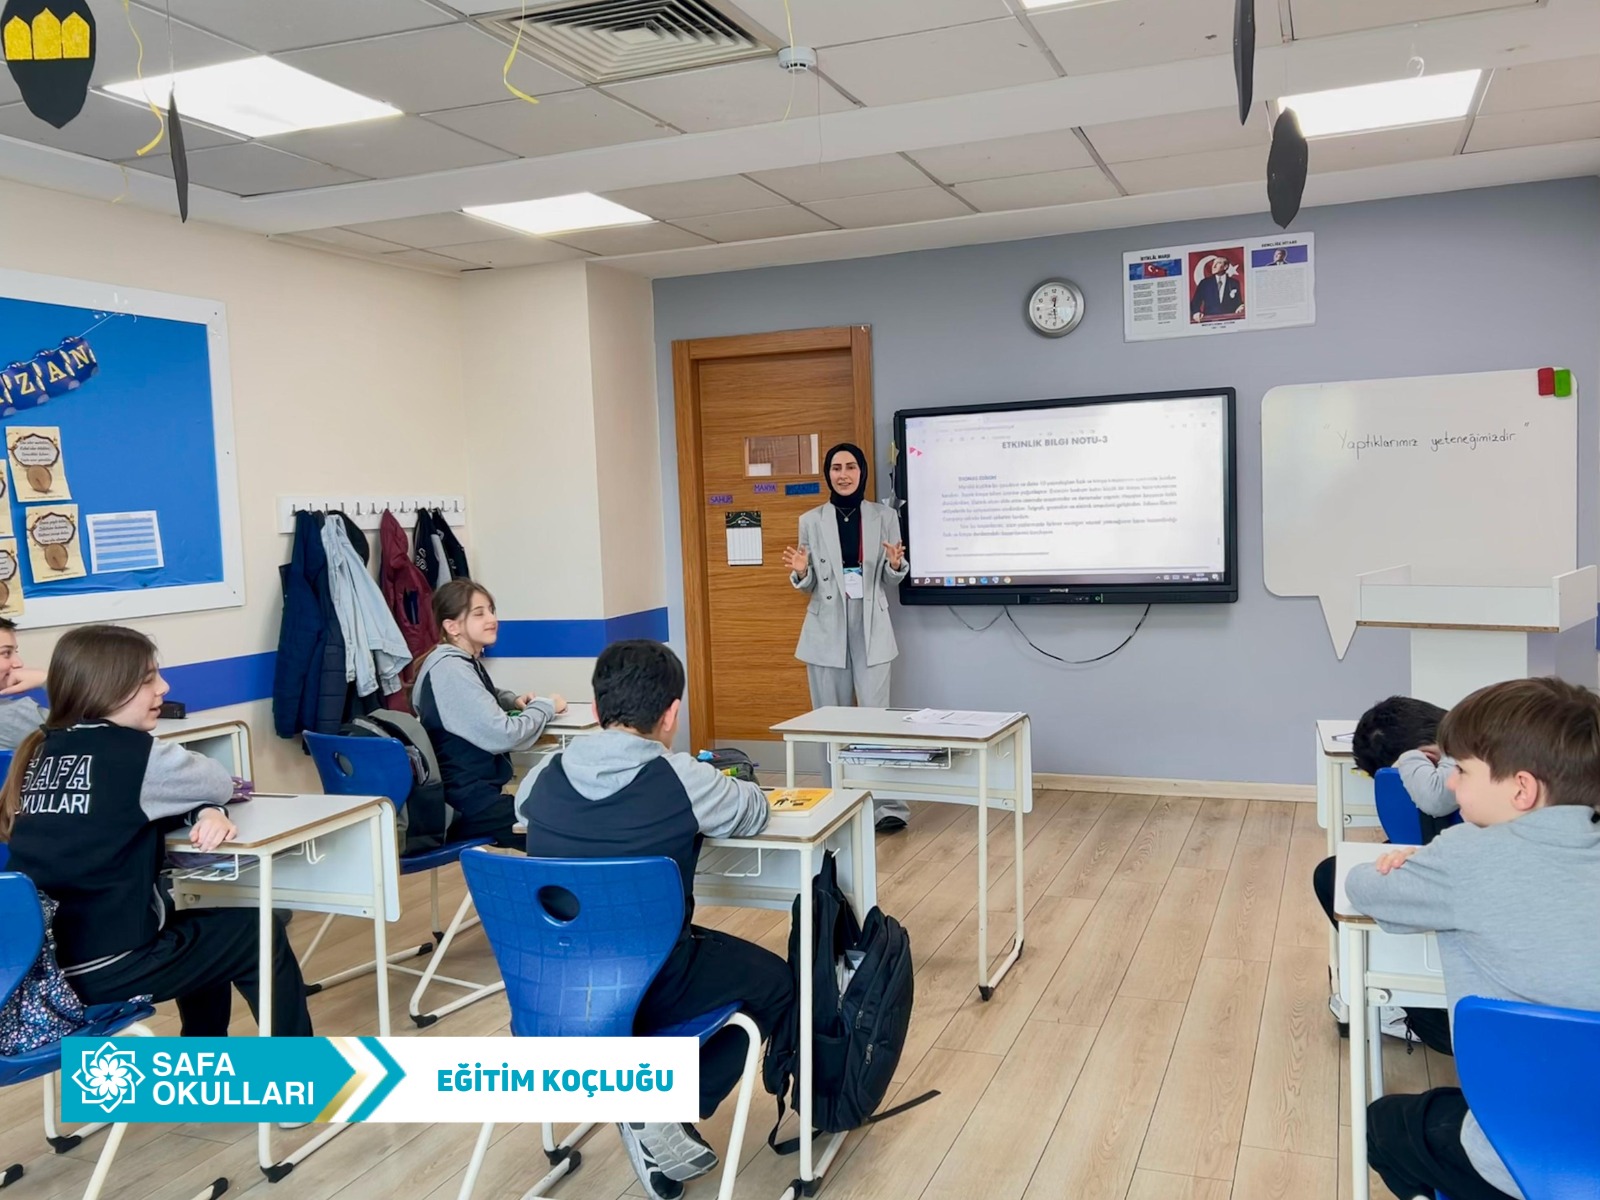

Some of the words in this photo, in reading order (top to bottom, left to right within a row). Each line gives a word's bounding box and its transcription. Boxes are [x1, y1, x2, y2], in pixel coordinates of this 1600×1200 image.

[0, 345, 90, 404] ZAN
[1071, 435, 1109, 446] NOTU-3
[1431, 428, 1516, 452] yeteneğimizdir
[18, 793, 90, 814] KULLARI
